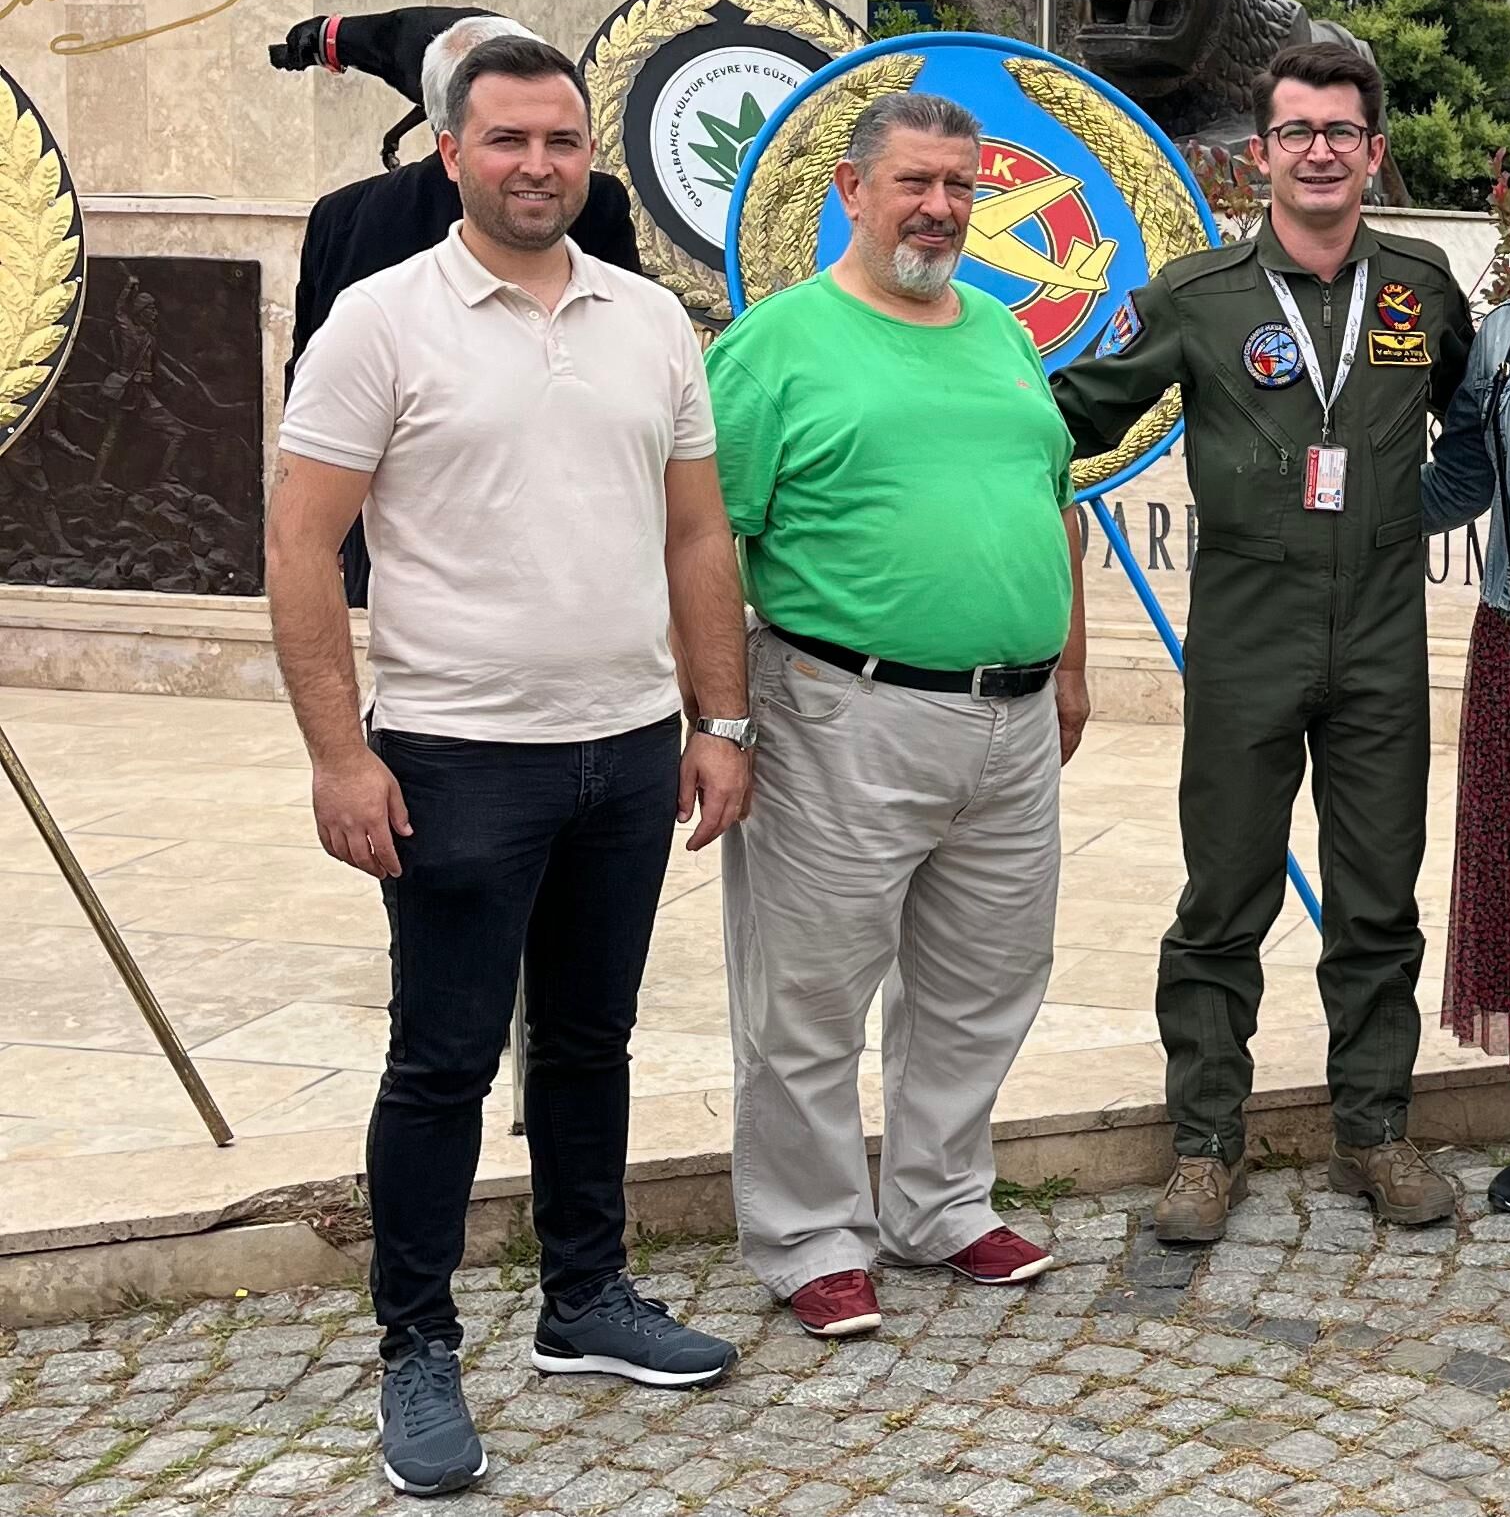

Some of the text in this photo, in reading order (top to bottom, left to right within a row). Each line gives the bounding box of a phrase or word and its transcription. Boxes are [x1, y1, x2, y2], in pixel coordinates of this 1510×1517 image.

[706, 64, 741, 82] ÇEVRE
[744, 64, 760, 74] VE
[673, 76, 706, 119] KÜLTÜR
[669, 121, 703, 208] GÜZELBAHÇE
